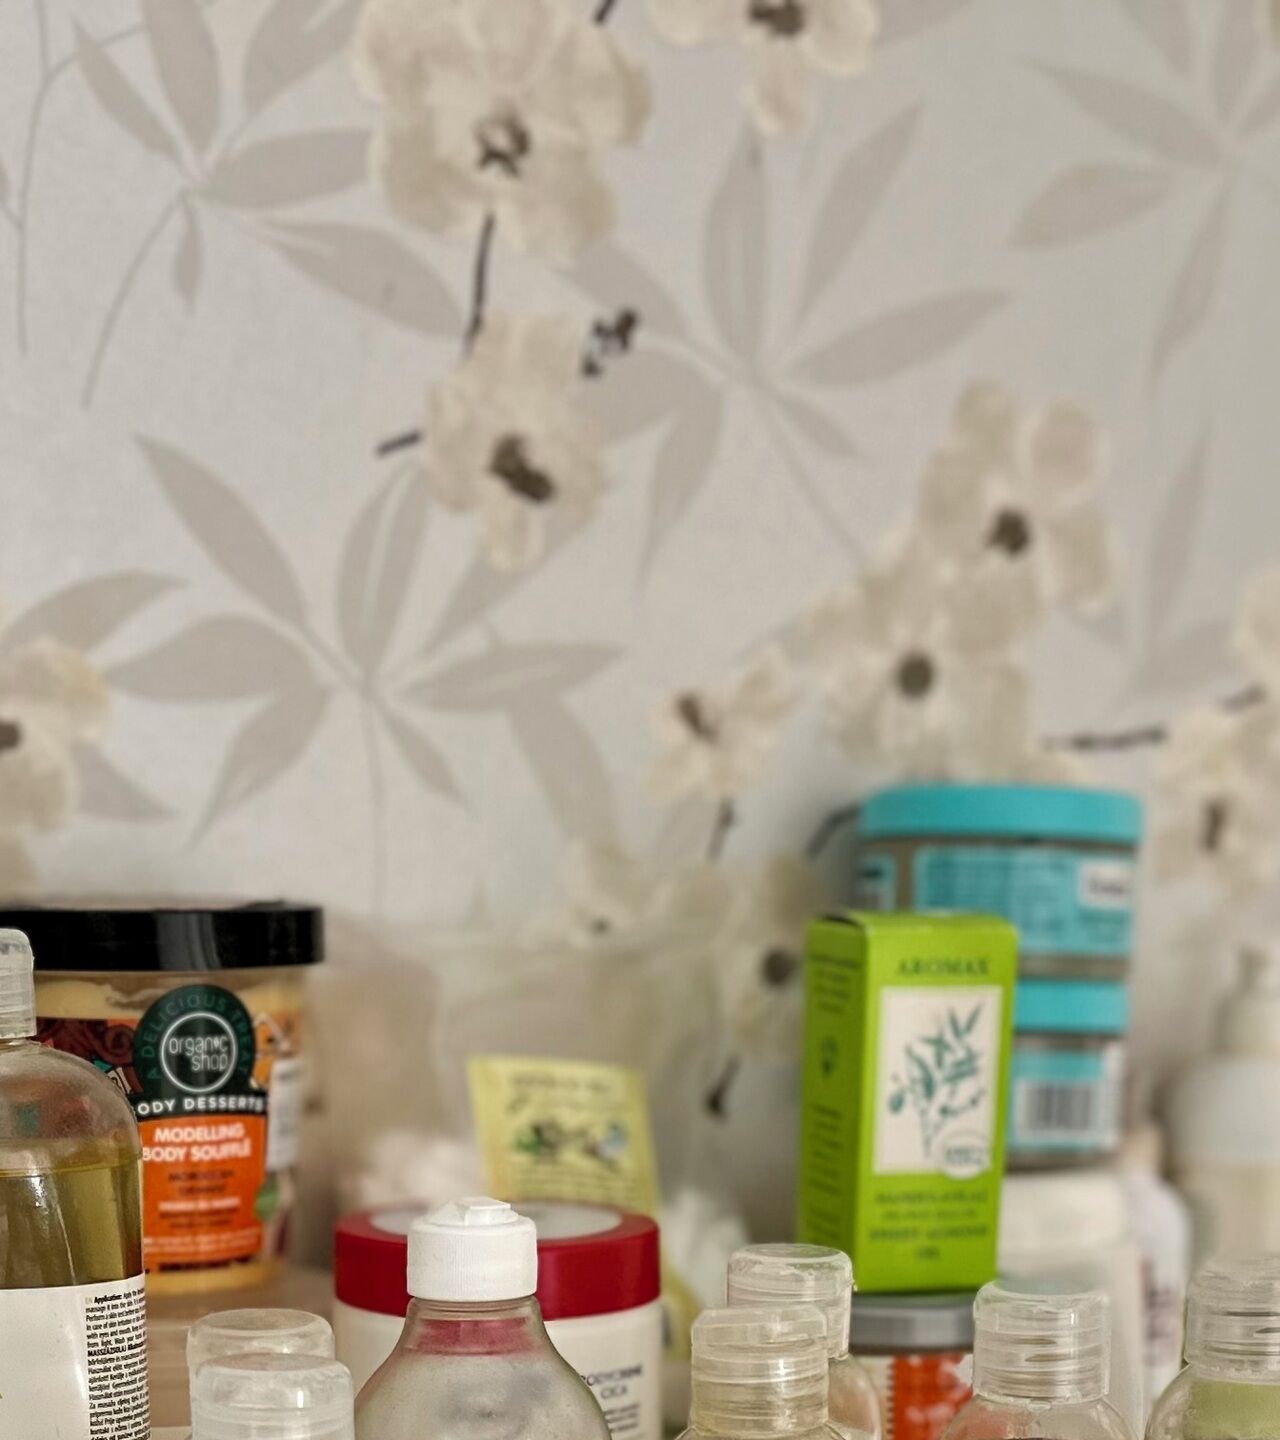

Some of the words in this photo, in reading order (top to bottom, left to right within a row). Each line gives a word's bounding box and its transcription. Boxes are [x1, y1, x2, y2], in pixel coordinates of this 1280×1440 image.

[191, 1051, 228, 1071] shop
[136, 1099, 177, 1115] ODY
[184, 1096, 265, 1112] DESSERTS
[154, 1121, 246, 1143] MODELLING
[142, 1146, 186, 1162] BODY
